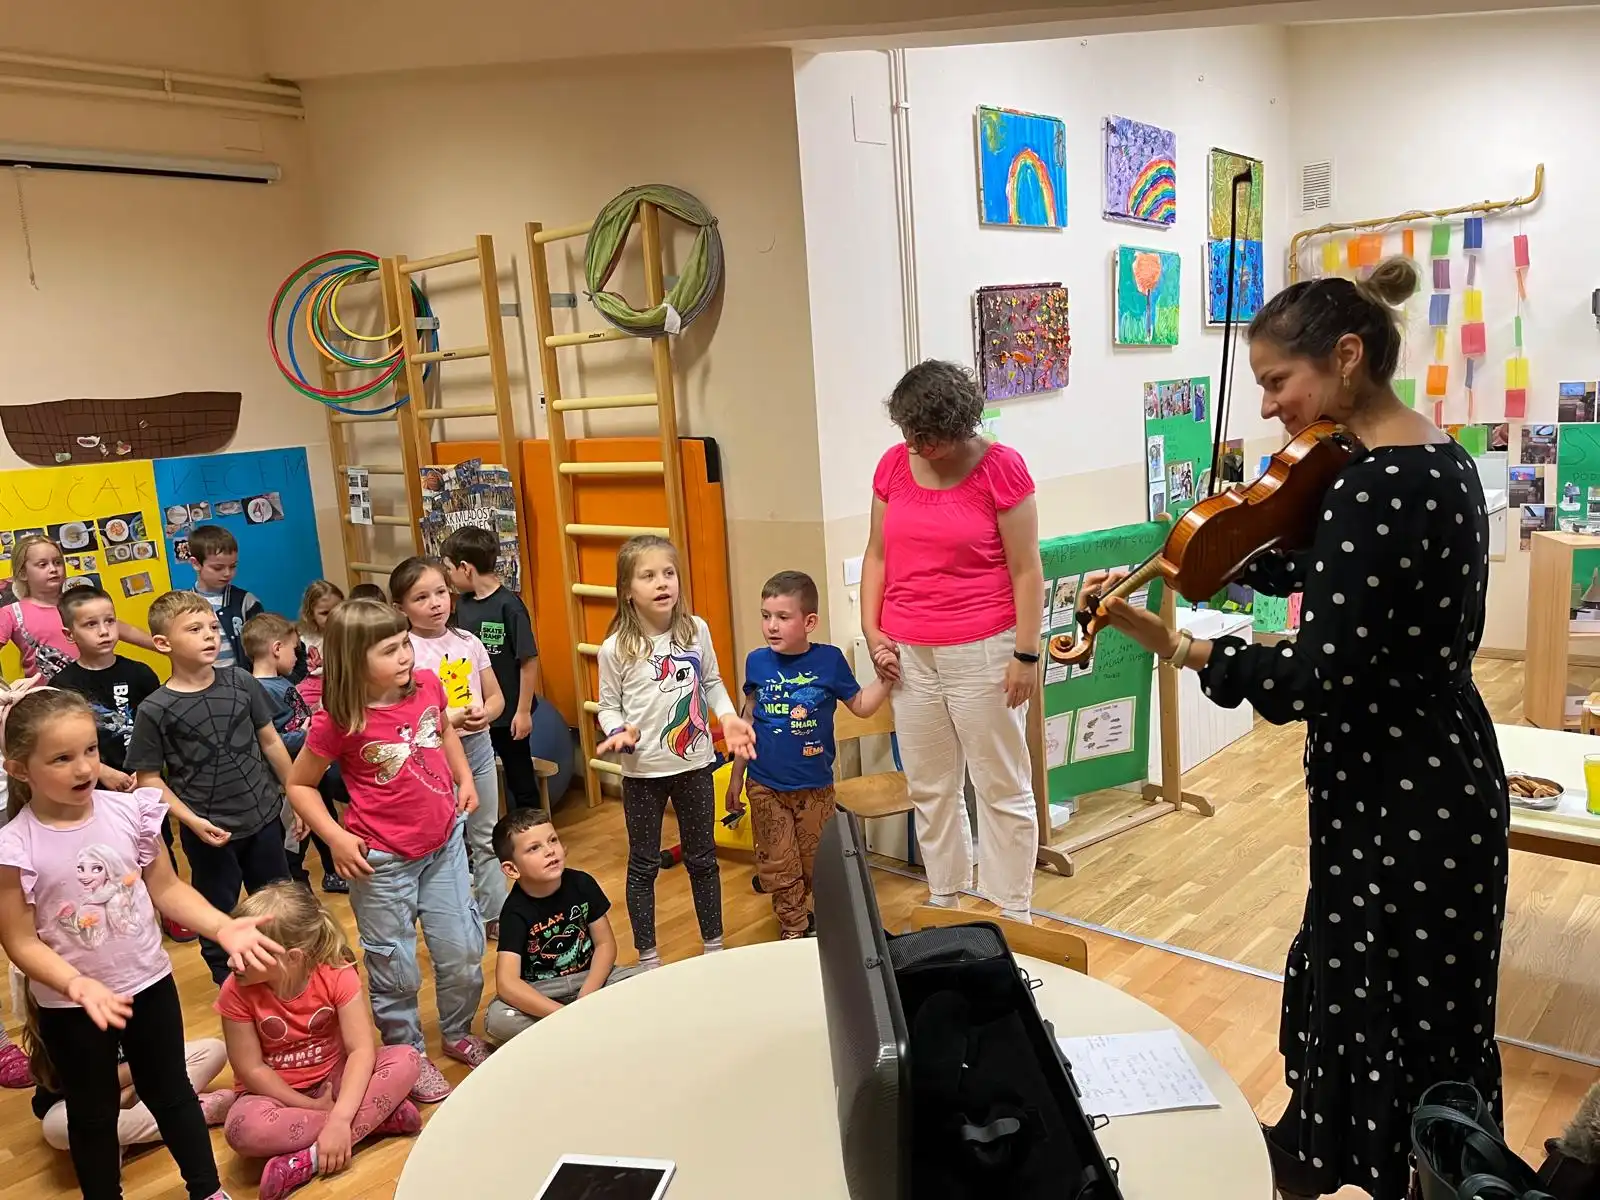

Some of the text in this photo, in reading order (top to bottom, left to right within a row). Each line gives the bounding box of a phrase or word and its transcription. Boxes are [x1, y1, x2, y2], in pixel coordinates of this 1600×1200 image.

[0, 472, 154, 518] UČAK
[770, 684, 782, 692] I'M
[763, 703, 790, 715] NICE
[790, 719, 818, 729] SHARK
